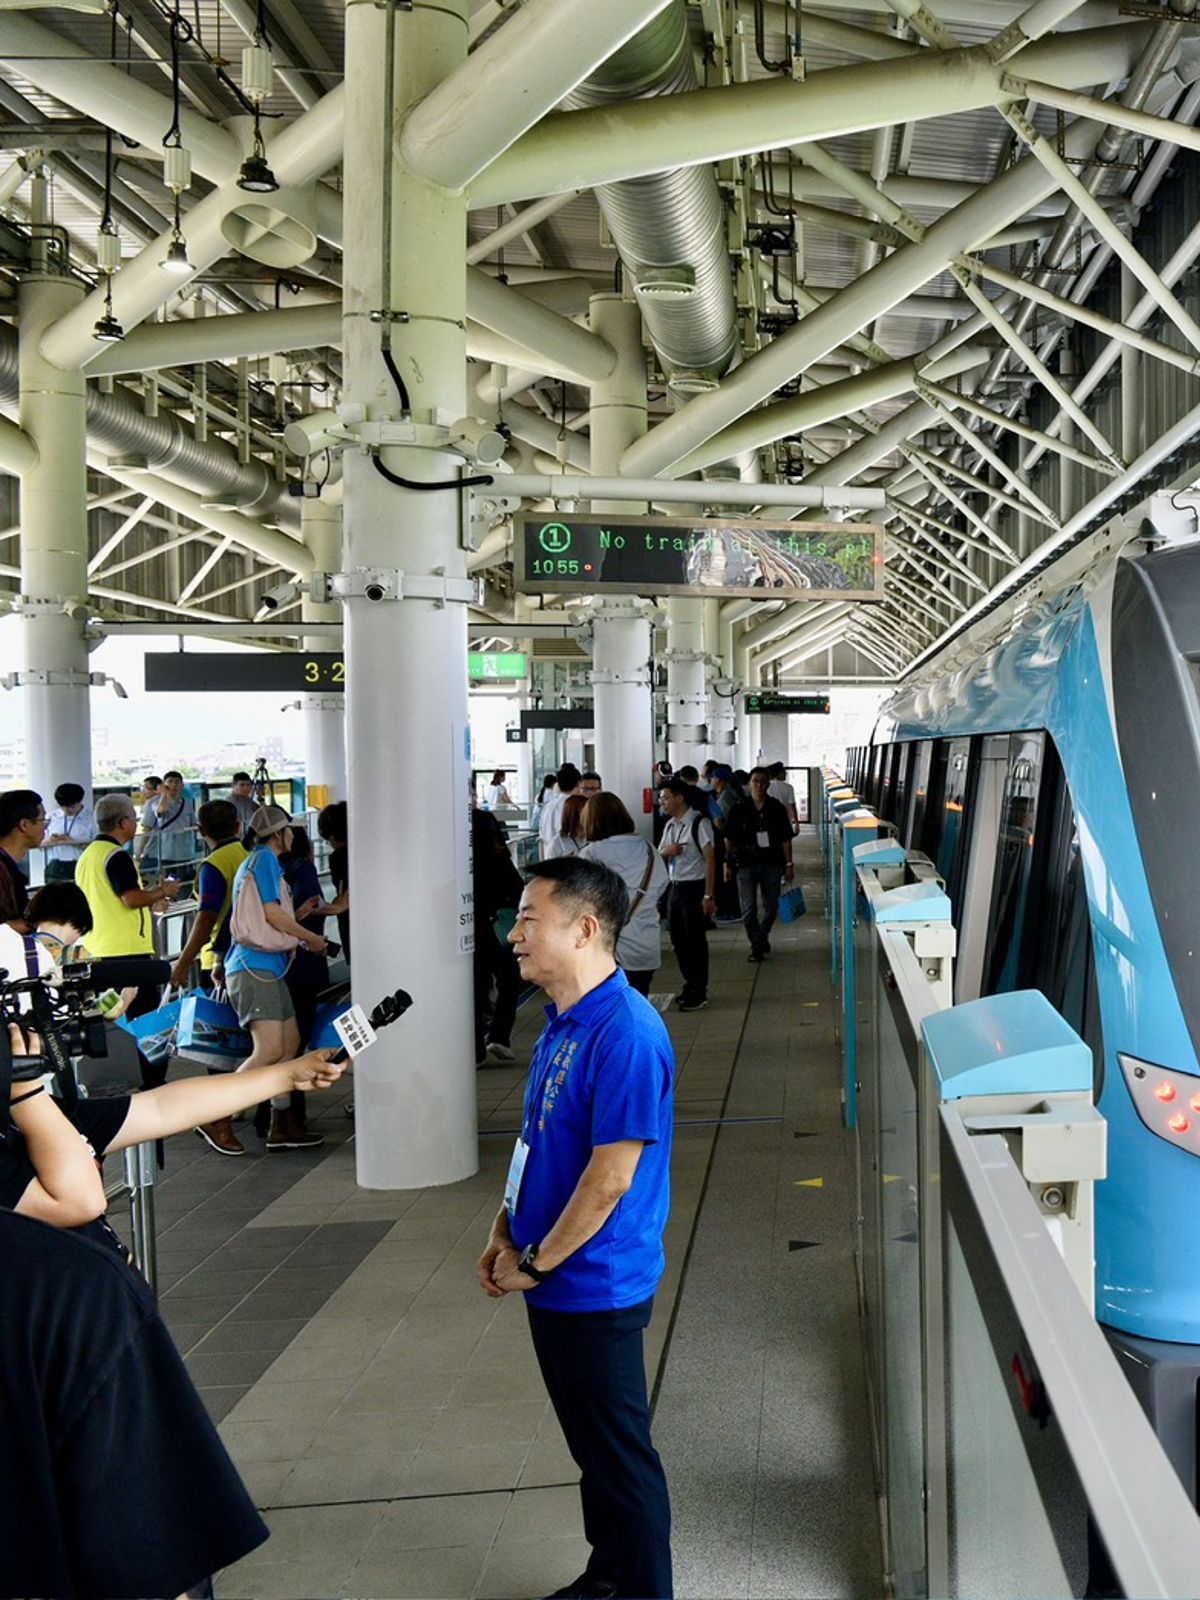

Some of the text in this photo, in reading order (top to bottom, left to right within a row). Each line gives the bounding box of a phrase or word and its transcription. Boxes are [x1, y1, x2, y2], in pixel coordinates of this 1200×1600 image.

[600, 531, 626, 549] No
[645, 533, 713, 551] train
[776, 537, 827, 555] this
